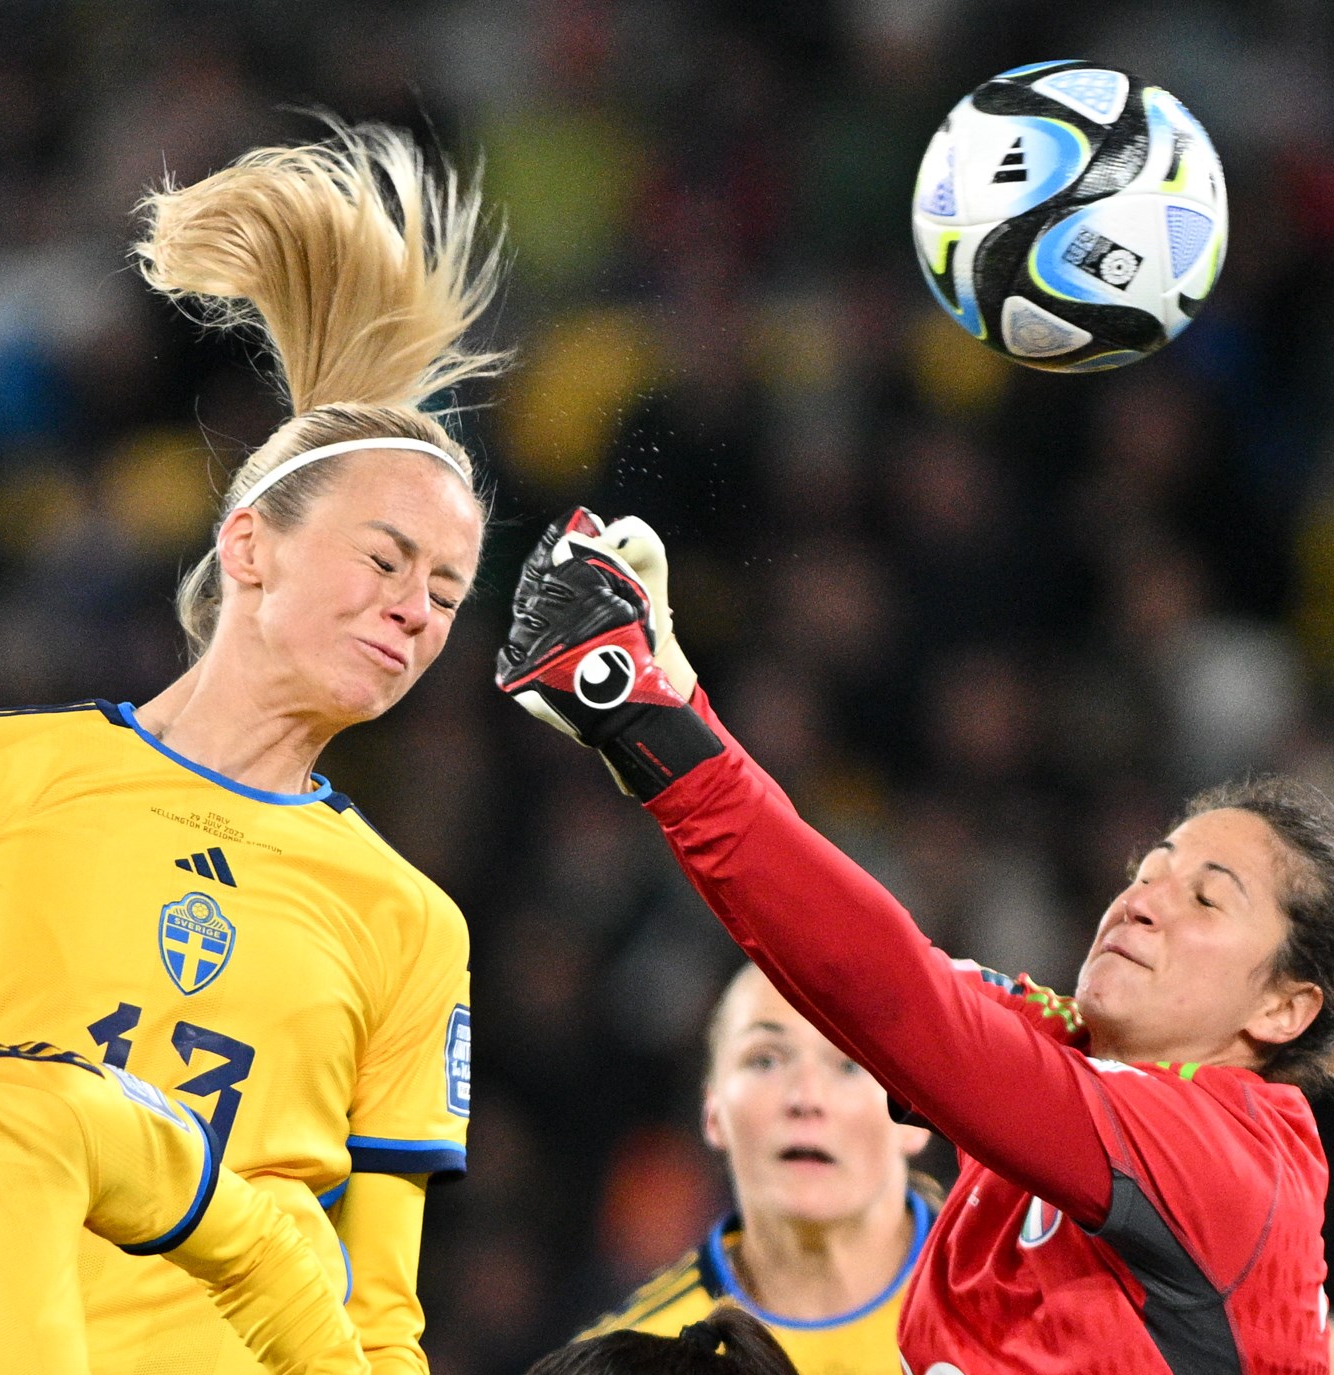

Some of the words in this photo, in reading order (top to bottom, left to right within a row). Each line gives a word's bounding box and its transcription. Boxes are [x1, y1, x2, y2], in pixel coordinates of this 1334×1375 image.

[150, 806, 200, 829] WELLINGTON
[190, 813, 200, 821] 29
[203, 818, 222, 830] JULY
[224, 826, 244, 839] 2023
[207, 812, 230, 825] ITALY
[174, 917, 221, 938] SVERIGE
